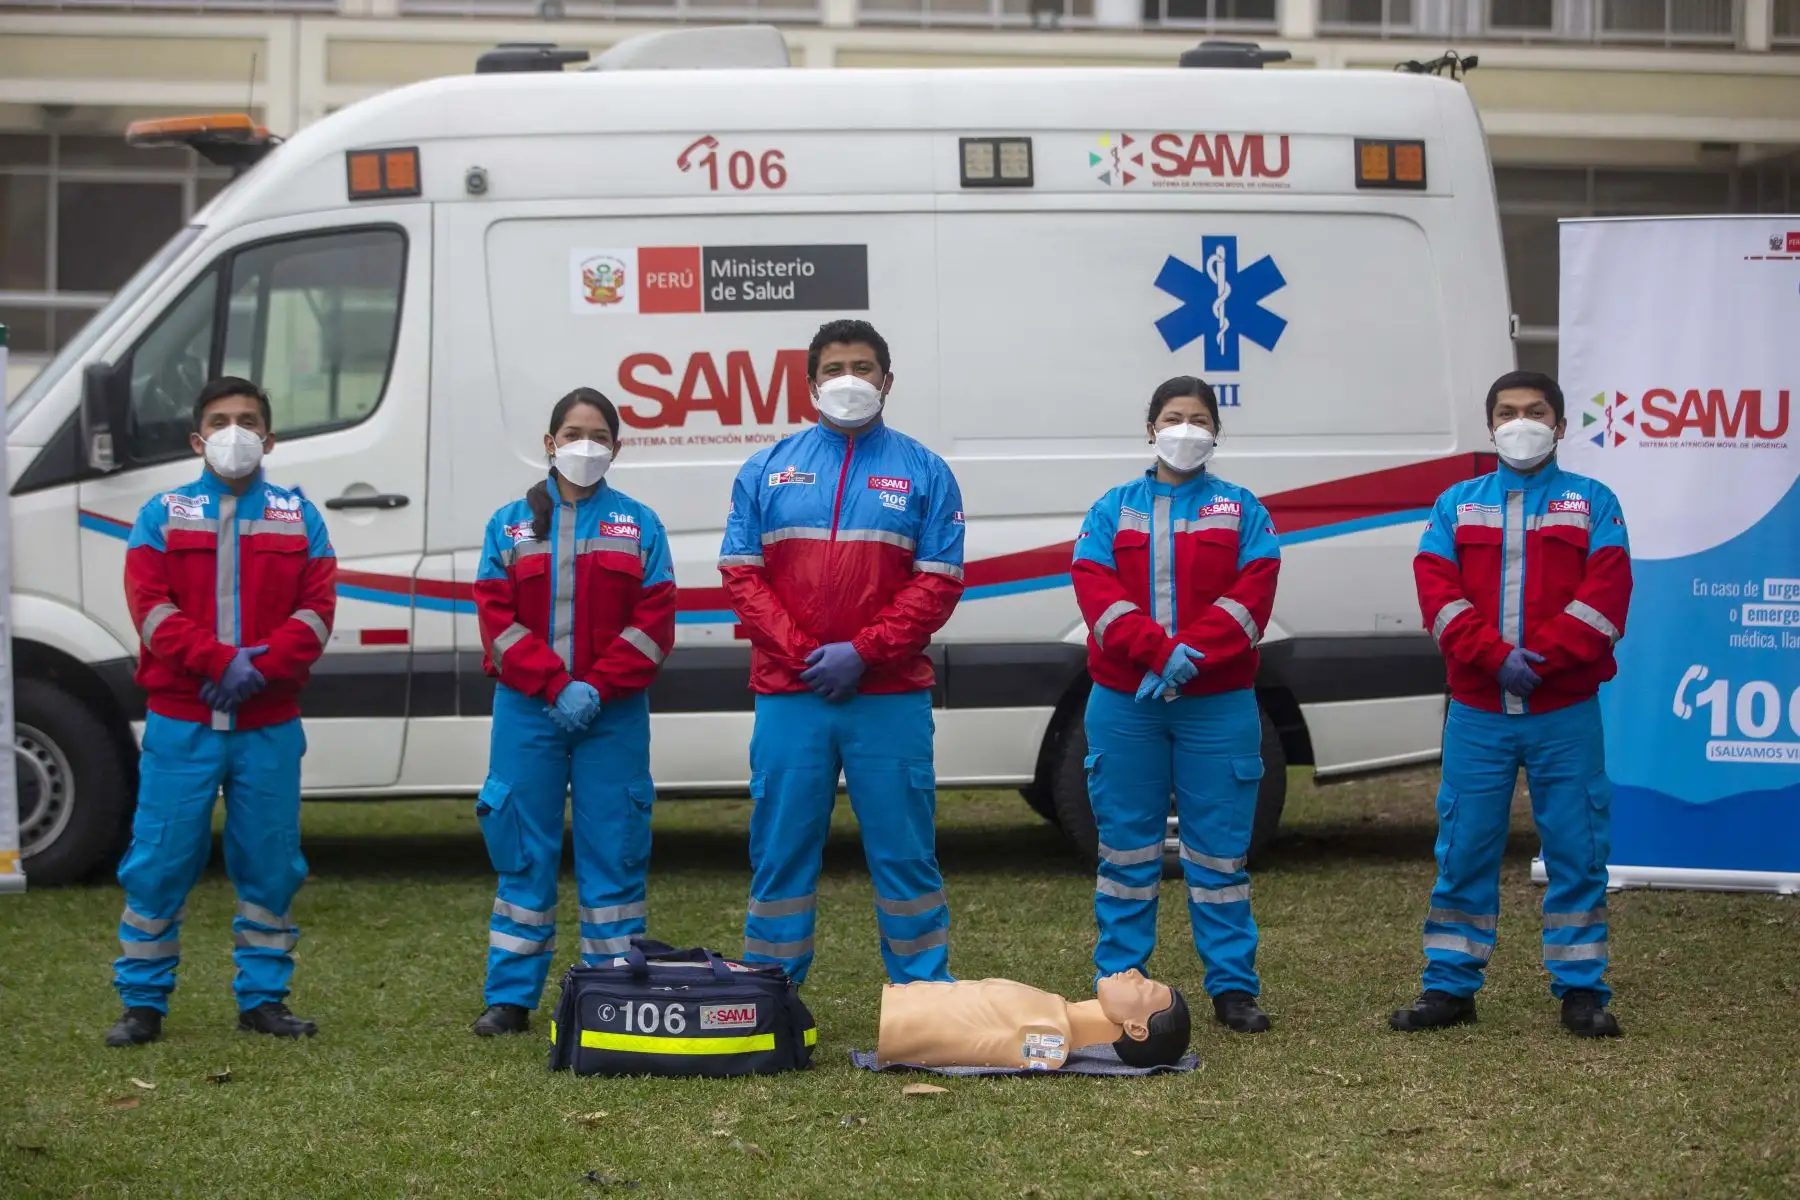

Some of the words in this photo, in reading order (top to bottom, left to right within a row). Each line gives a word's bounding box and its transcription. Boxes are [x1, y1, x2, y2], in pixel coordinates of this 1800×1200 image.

[1151, 132, 1290, 178] SAMU
[699, 150, 787, 191] 106
[710, 257, 815, 278] Ministerio
[646, 268, 694, 289] PERÚ
[711, 281, 736, 301] de
[742, 280, 795, 300] Salud
[617, 348, 820, 430] SAM
[1640, 388, 1790, 439] SAMU
[669, 436, 684, 446] DE
[1639, 440, 1669, 448] SISTEMA
[1751, 441, 1787, 449] URGENCIA
[881, 478, 908, 490] SAMU
[884, 493, 907, 506] 106
[1213, 503, 1240, 513] SAMU
[1564, 500, 1589, 511] SAMU
[614, 525, 641, 538] SAMU
[1693, 578, 1708, 596] En
[1711, 583, 1740, 597] caso
[1743, 580, 1759, 597] de
[1729, 608, 1738, 622] o
[1729, 630, 1778, 650] médica,
[1696, 679, 1800, 738] 10
[1710, 746, 1783, 759] ¡SALVAMOS
[618, 1001, 687, 1034] 106
[717, 1008, 755, 1022] SAMU
